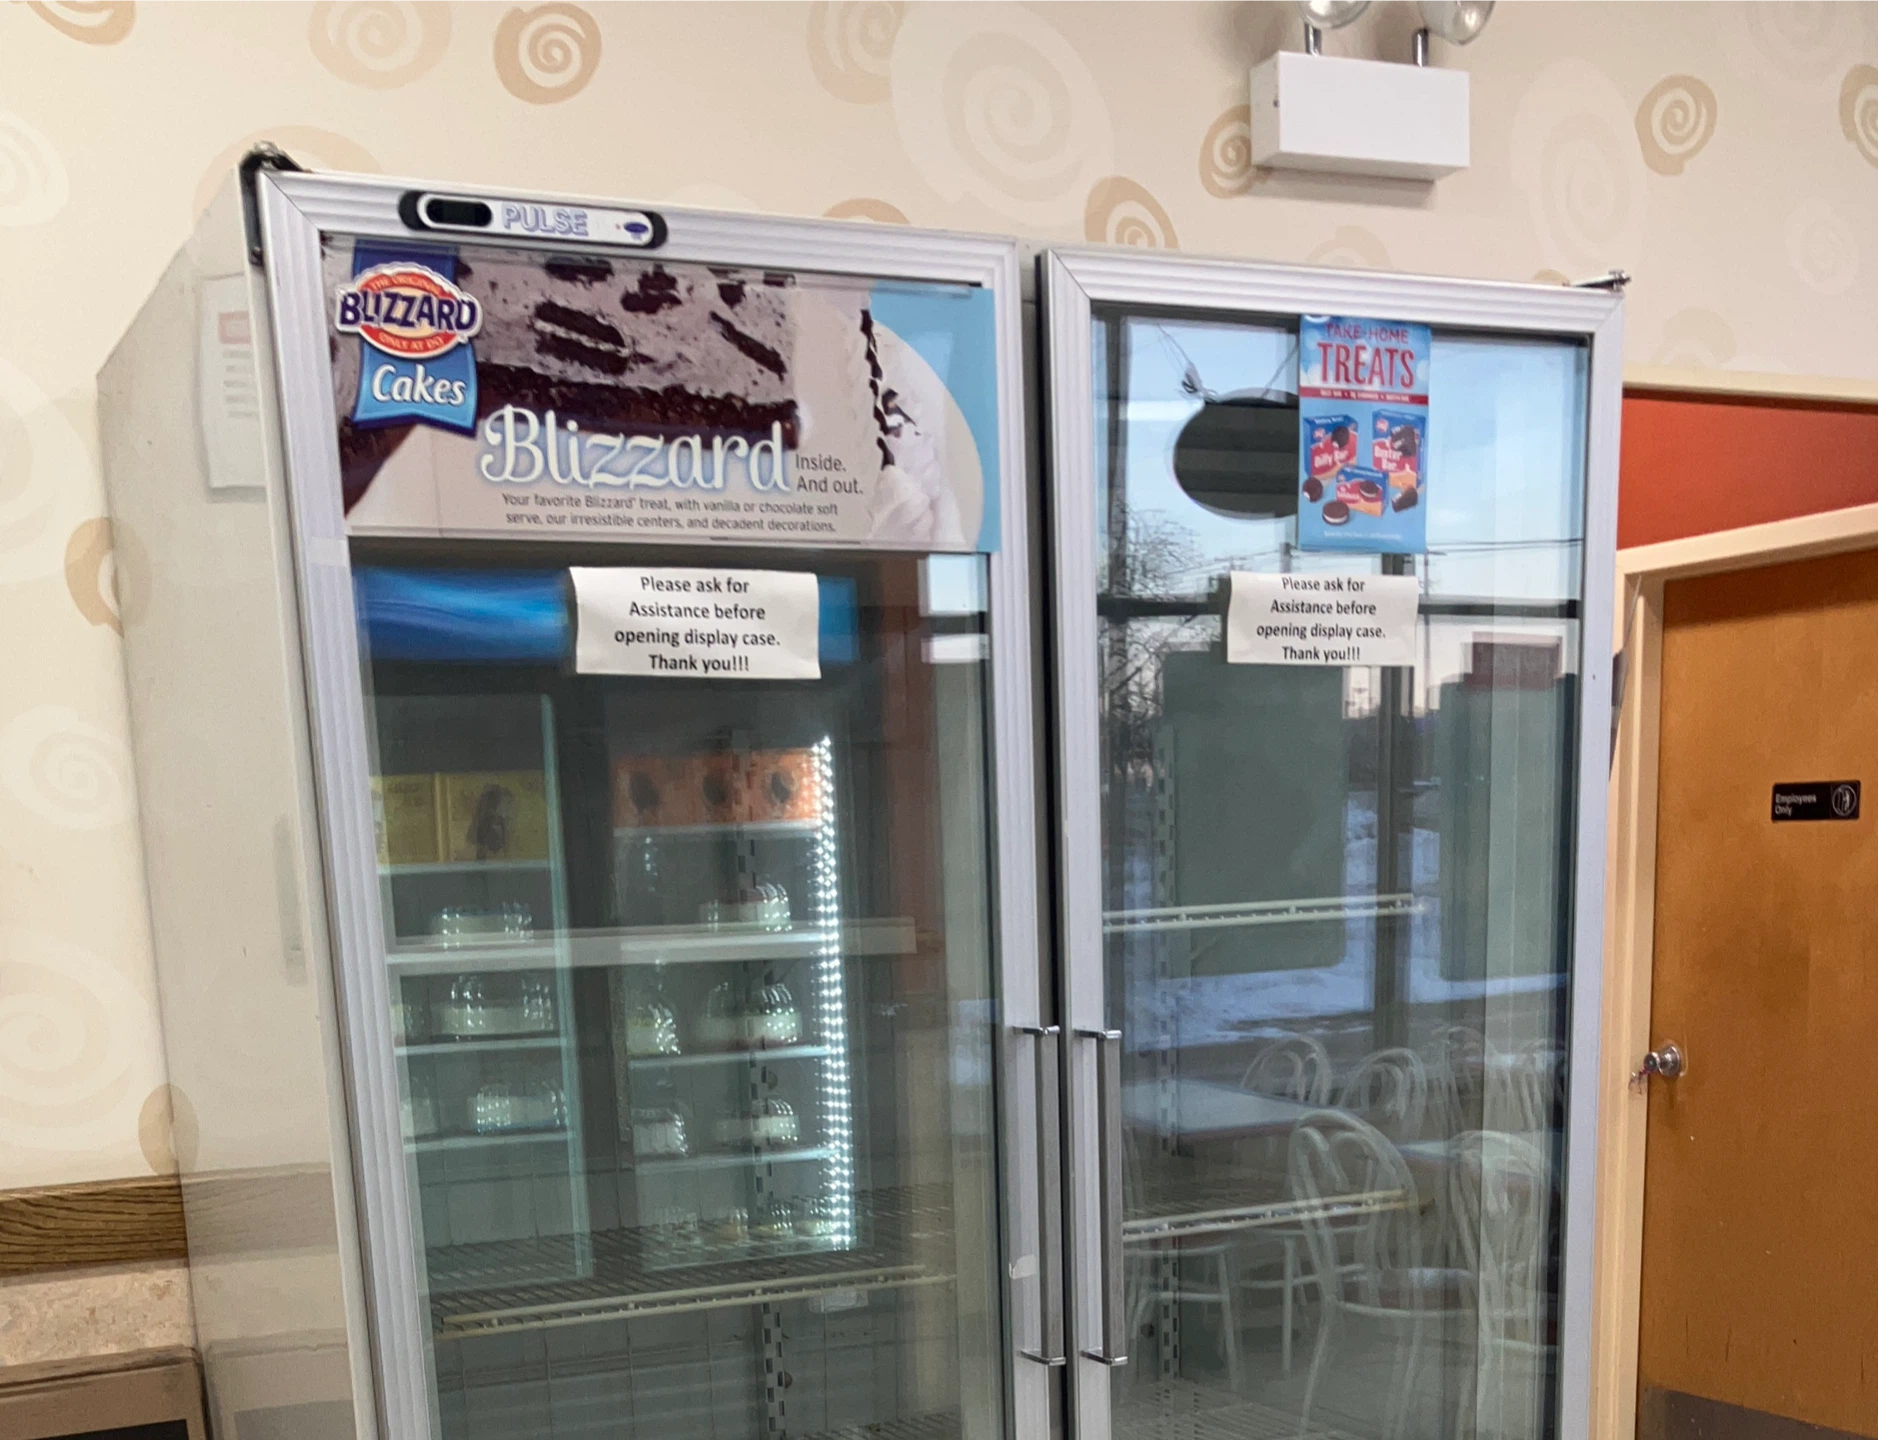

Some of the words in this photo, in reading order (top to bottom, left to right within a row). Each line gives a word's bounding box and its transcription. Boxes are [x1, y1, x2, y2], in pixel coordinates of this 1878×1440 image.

[501, 202, 589, 237] PULSE
[340, 289, 477, 331] BLIZZARD
[1317, 341, 1415, 389] TREATS
[372, 364, 467, 405] Cakes
[480, 403, 792, 492] Blizzard
[795, 453, 847, 472] Inside.
[797, 475, 829, 494] And
[833, 479, 864, 495] out.
[502, 493, 530, 506] Your
[534, 493, 581, 508] favorite
[639, 497, 671, 511] treat,
[675, 499, 700, 512] with
[704, 500, 740, 513] vanilla
[743, 503, 755, 513] or
[759, 501, 814, 515] chocolate
[817, 503, 838, 515] soft
[506, 513, 543, 525] serve,
[546, 514, 567, 525] our
[570, 512, 634, 527] irresistible
[637, 516, 684, 529] centers,
[687, 517, 708, 529] and
[712, 518, 764, 531] decadent
[768, 519, 836, 532] decorations.
[640, 576, 691, 593] Please
[696, 576, 721, 593] ask
[727, 576, 749, 594] for
[1281, 577, 1320, 591] Please
[1324, 577, 1344, 591] ask
[1347, 577, 1365, 592] for
[629, 602, 710, 619] Assistance
[714, 603, 766, 620] before
[1270, 599, 1333, 614] Assistance
[1336, 600, 1377, 615] before
[614, 629, 680, 647] opening
[684, 629, 738, 647] display
[742, 632, 781, 646] case.
[1256, 623, 1307, 639] opening
[1310, 624, 1351, 639] display
[1356, 626, 1386, 638] case.
[650, 654, 698, 671] Thank
[702, 655, 749, 673] you!!!
[1282, 646, 1320, 660] Thank
[1324, 647, 1360, 663] you!!!
